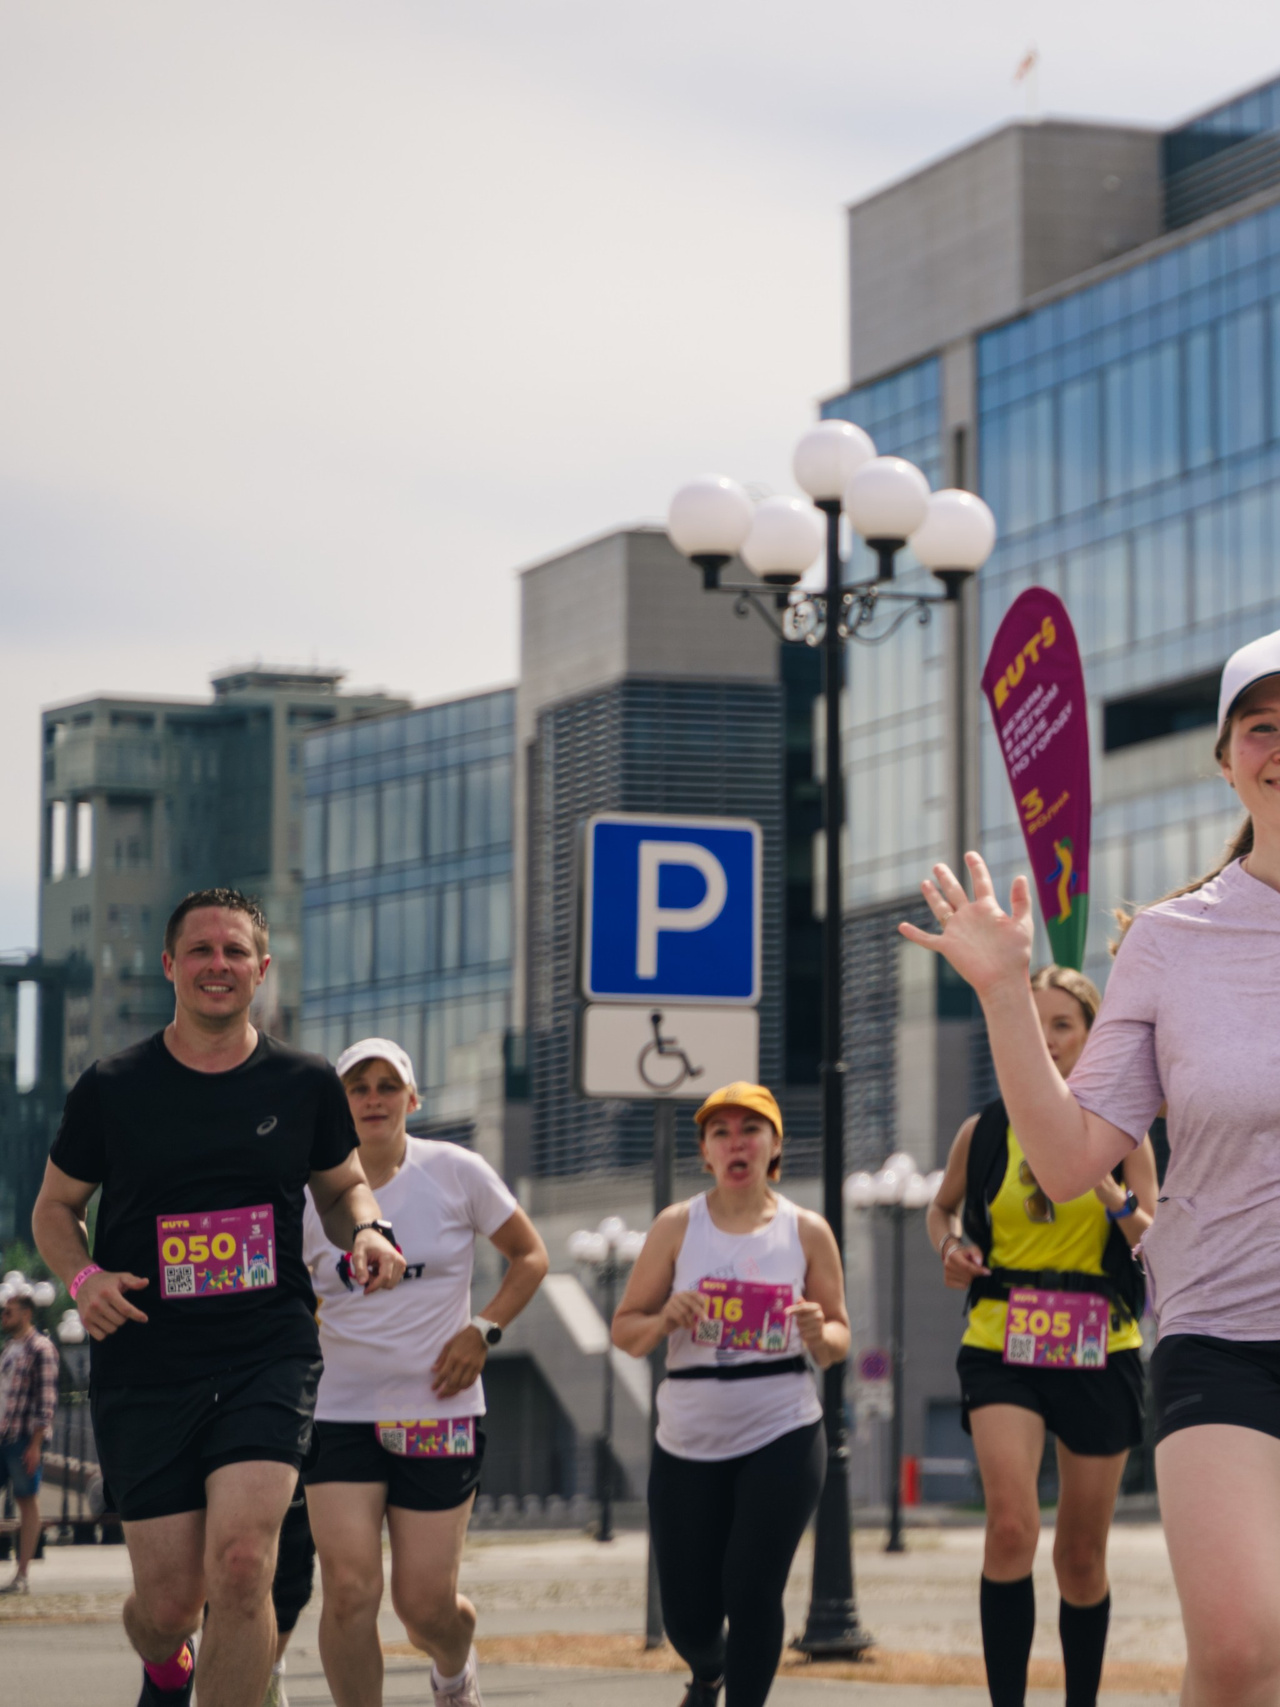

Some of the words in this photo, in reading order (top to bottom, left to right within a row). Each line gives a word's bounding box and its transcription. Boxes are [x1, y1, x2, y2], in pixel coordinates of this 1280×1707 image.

[1021, 788, 1044, 821] 3
[636, 839, 728, 980] P
[162, 1232, 236, 1264] 050
[1008, 1307, 1071, 1338] 305
